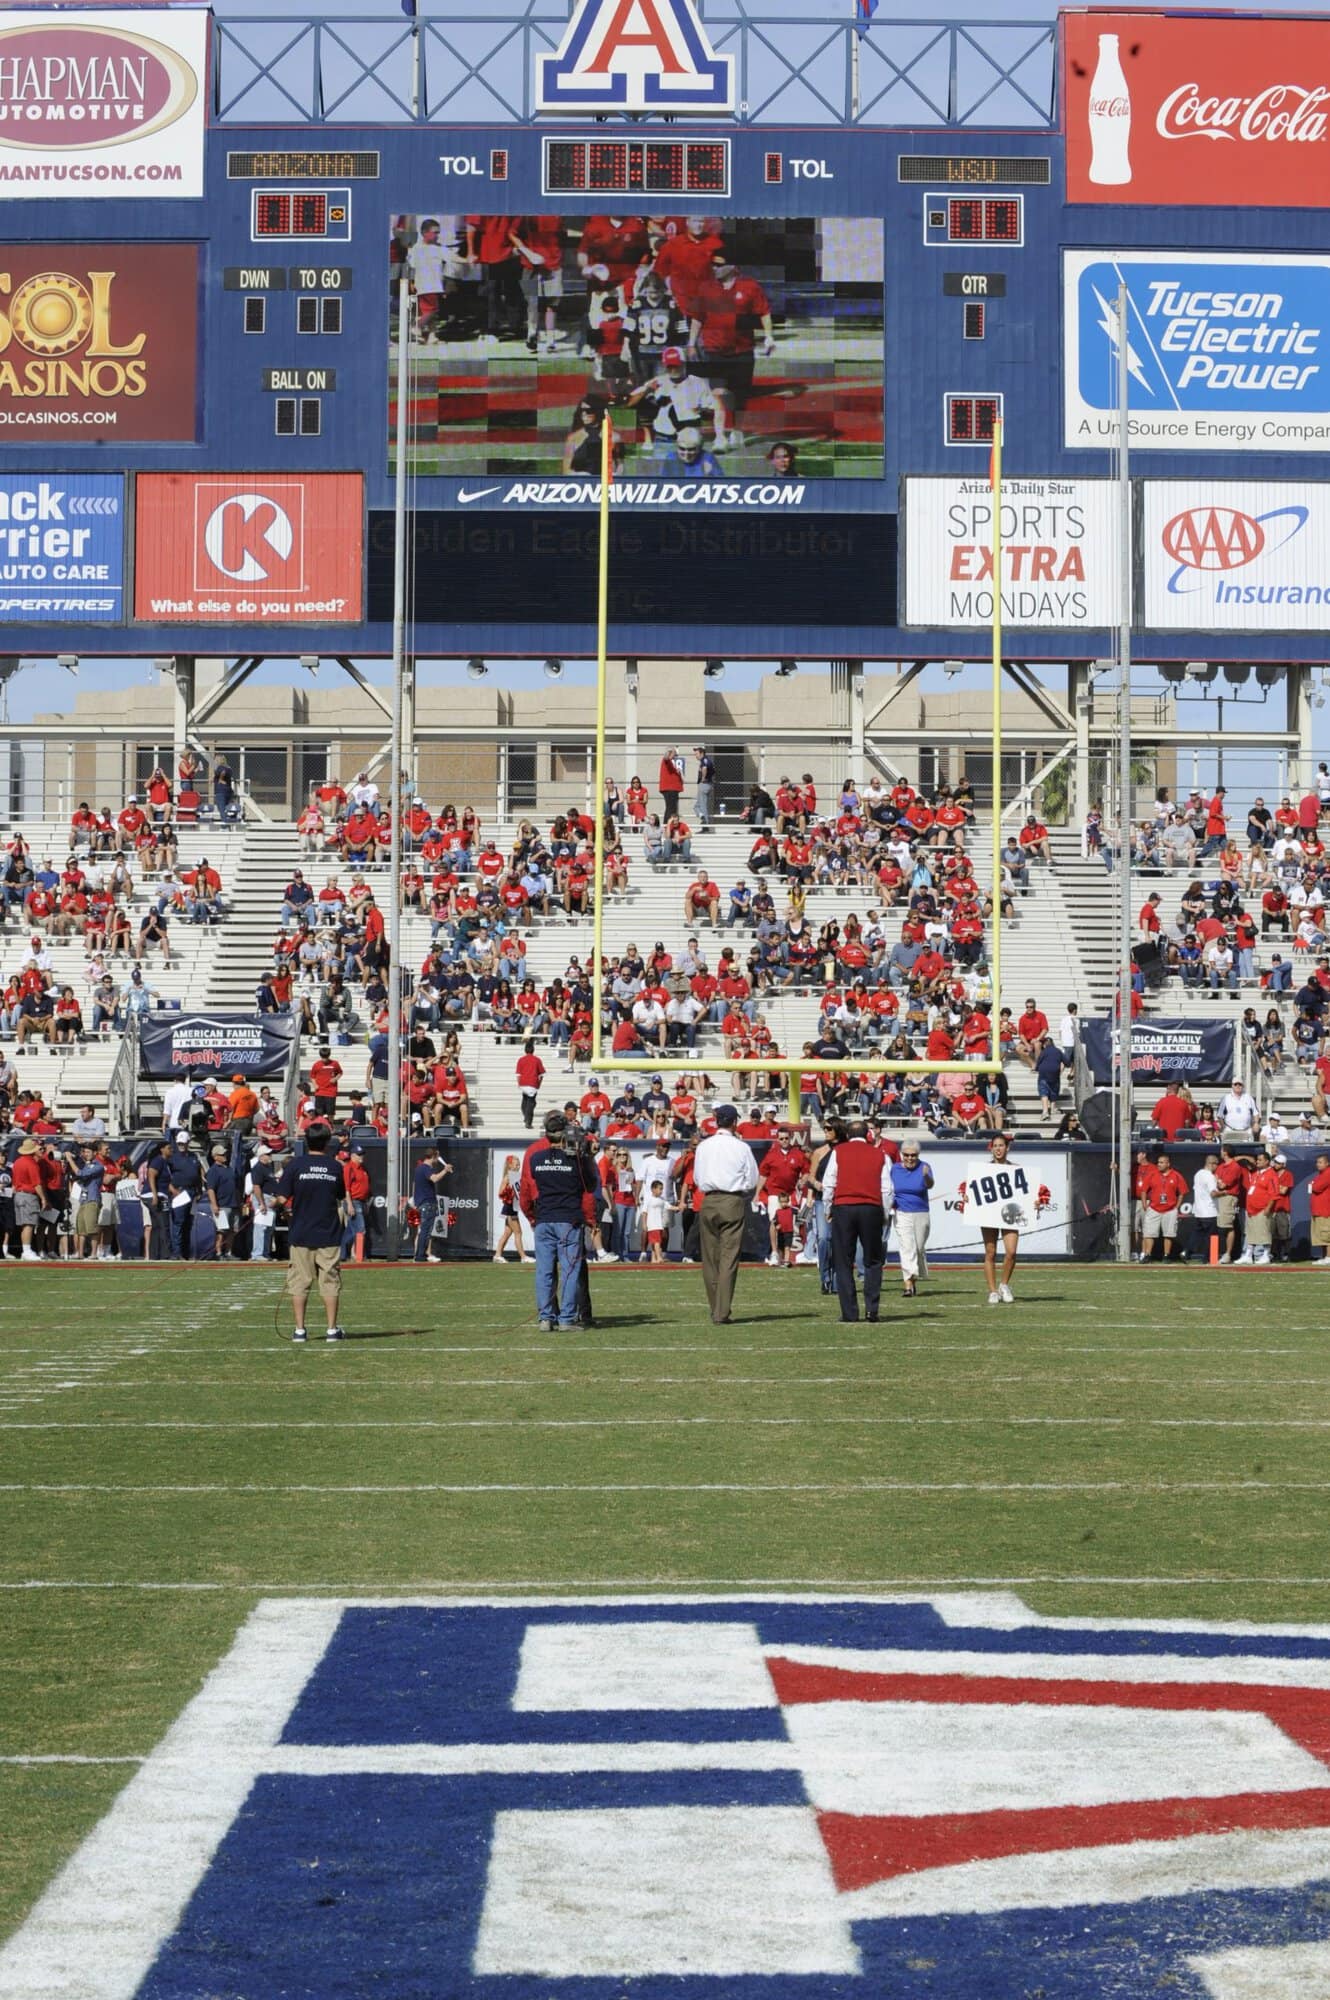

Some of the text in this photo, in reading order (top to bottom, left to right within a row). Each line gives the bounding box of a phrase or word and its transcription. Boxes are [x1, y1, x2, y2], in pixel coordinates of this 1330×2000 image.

[1156, 83, 1330, 143] Coca-Cola
[253, 154, 354, 177] ARIZONA
[440, 156, 484, 175] TOL
[789, 159, 834, 178] TOL
[948, 160, 996, 183] WSU
[240, 270, 270, 288] DWN
[299, 270, 341, 288] TO GO
[961, 275, 988, 294] QTR
[1147, 282, 1283, 318] Tucson
[0, 272, 147, 357] OL
[1160, 318, 1320, 354] Electric
[271, 371, 326, 389] BALL ON
[1177, 355, 1320, 390] Power
[1078, 420, 1091, 434] A
[1097, 420, 1189, 436] UnSource
[1195, 421, 1257, 441] Energy
[502, 483, 806, 505] ARIZONAWILDCATS.COM
[958, 481, 1076, 497] Arizoa Daily Star
[948, 504, 1085, 539] SPORTS
[1169, 507, 1259, 570] AAA
[0, 565, 109, 580] UTO CARE
[950, 545, 1086, 582] EXTRA
[151, 599, 345, 616] What else do you need?
[951, 592, 1088, 619] MONDAYS
[172, 1029, 262, 1039] AMERICAN FAMILY
[1167, 1035, 1201, 1044] FAMILY
[969, 1168, 1029, 1207] 1984
